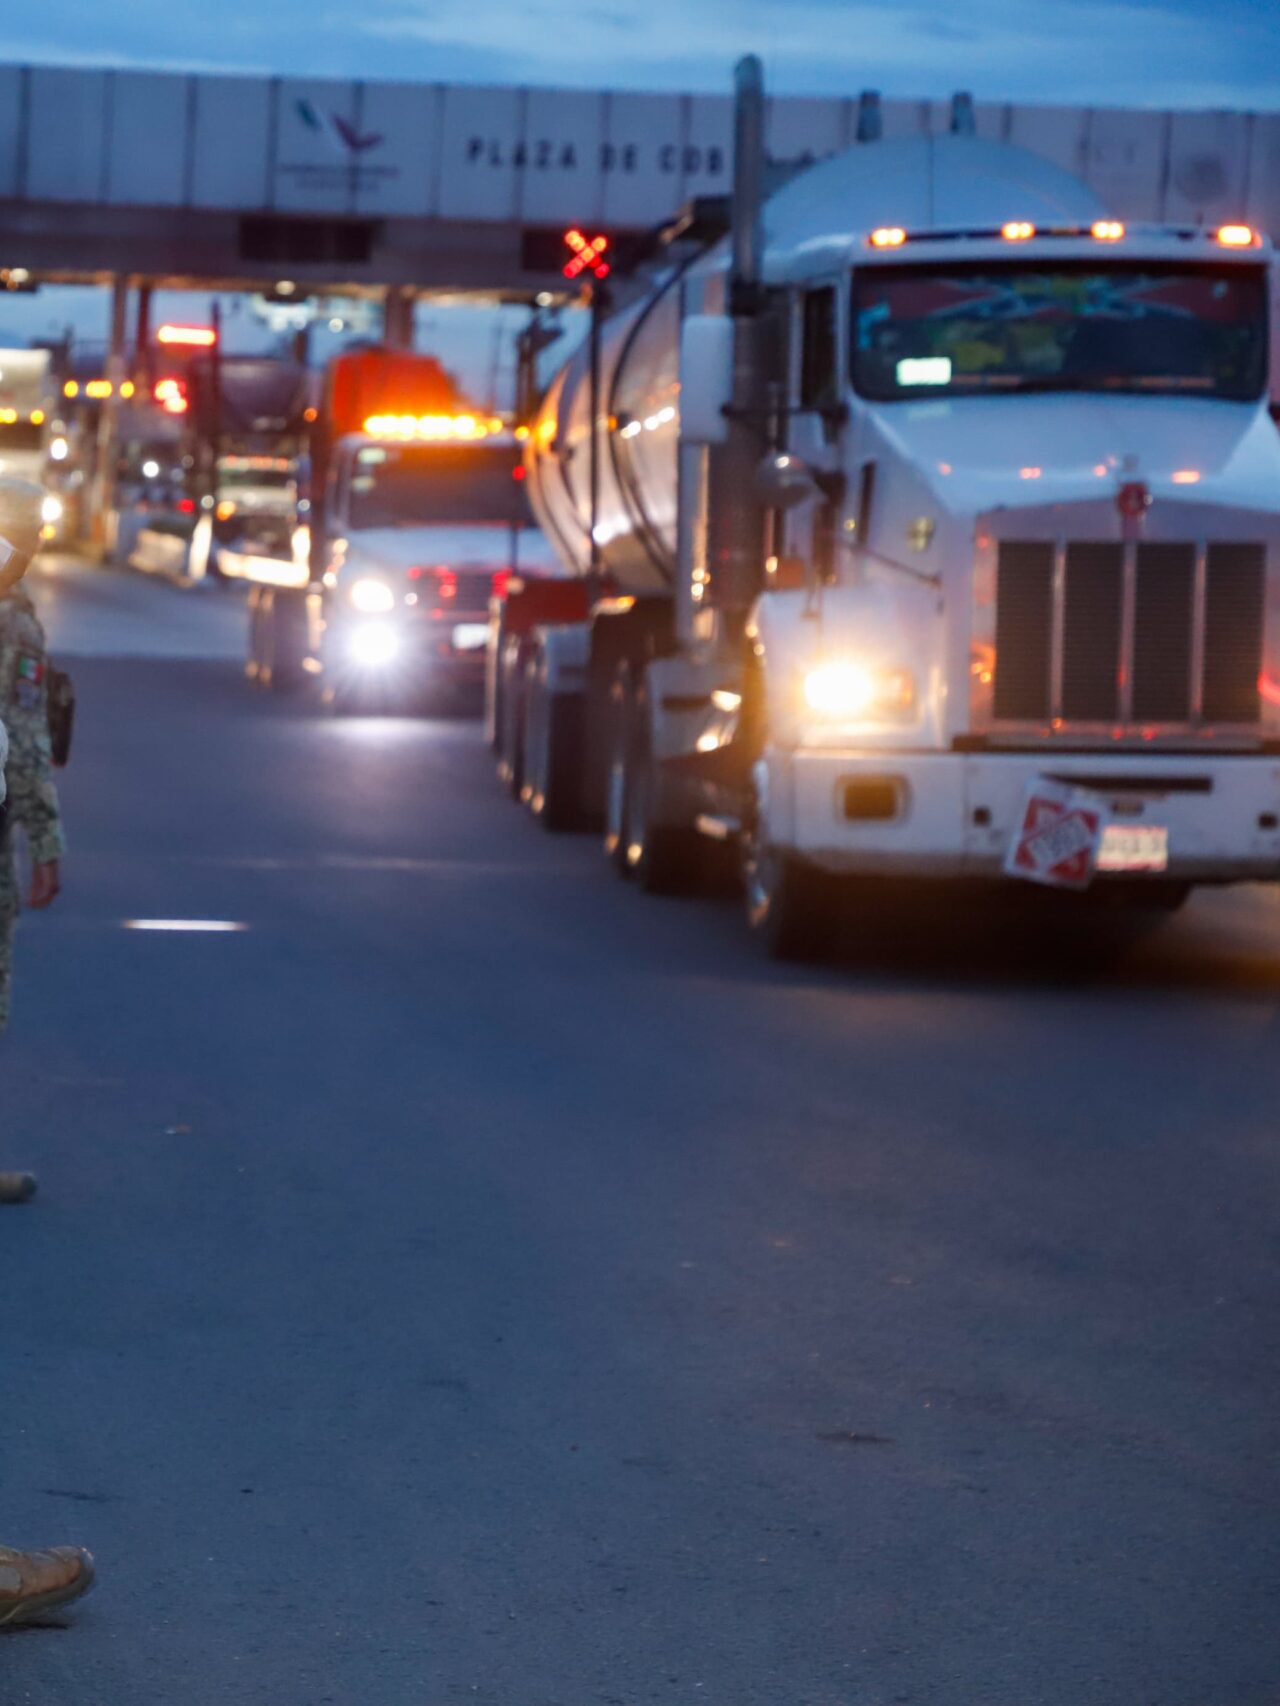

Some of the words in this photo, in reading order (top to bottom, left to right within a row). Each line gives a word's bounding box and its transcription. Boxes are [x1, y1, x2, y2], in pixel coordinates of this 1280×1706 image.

[466, 137, 577, 170] PLAZA
[600, 144, 638, 174] DE
[658, 144, 725, 177] COB
